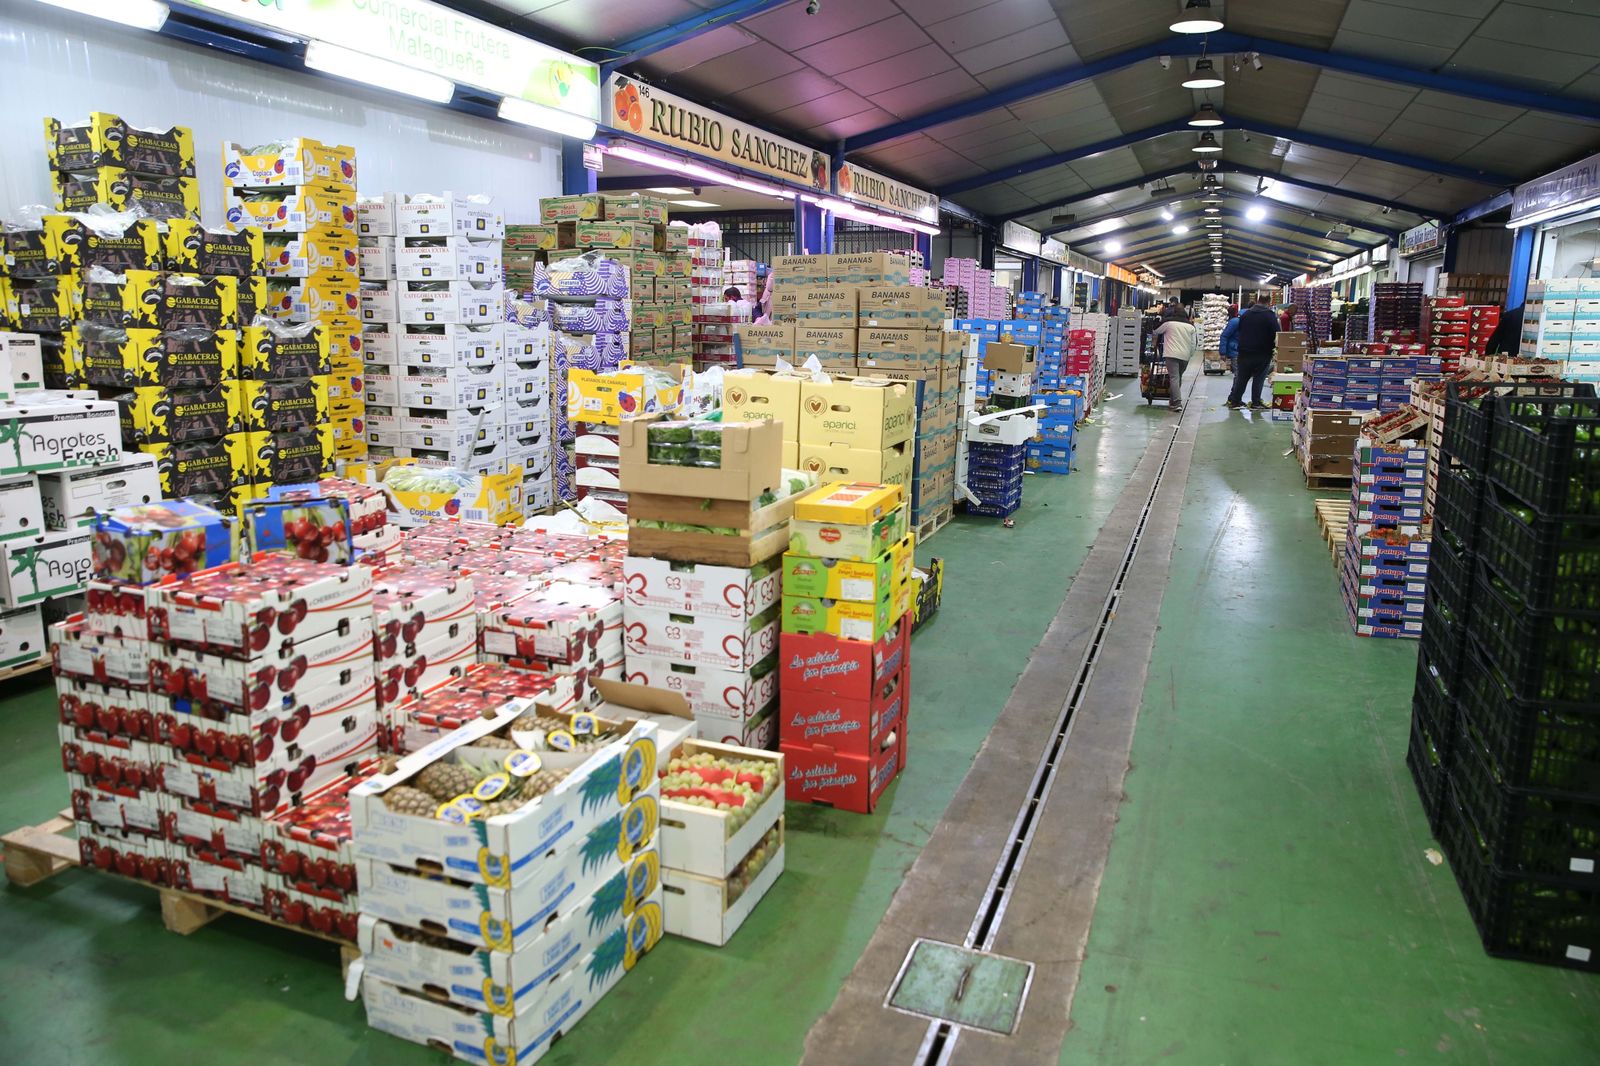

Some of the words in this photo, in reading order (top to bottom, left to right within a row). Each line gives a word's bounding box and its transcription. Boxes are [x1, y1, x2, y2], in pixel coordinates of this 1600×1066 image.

[454, 20, 510, 59] Frutera
[639, 85, 650, 98] 146
[138, 136, 178, 150] GABACERAS
[649, 97, 723, 152] RUBIO
[731, 127, 808, 179] SANCHEZ
[853, 171, 886, 203] RUBIO
[143, 189, 182, 200] GABACERAS
[213, 243, 250, 253] GABACERAS
[782, 257, 817, 266] BANANAS
[837, 256, 873, 265] BANANAS
[807, 292, 845, 300] BANANAS
[871, 291, 911, 299] BANANAS
[176, 296, 218, 306] GABACERAS
[747, 330, 784, 338] BANANAS
[806, 331, 843, 339] BANANAS
[870, 332, 909, 341] BANANAS
[178, 353, 219, 361] GABACERAS
[184, 402, 225, 412] GABACERAS
[279, 398, 314, 406] GABACERAS
[53, 413, 84, 422] Premium
[87, 410, 116, 418] Bananas
[743, 410, 774, 422] aparici
[884, 412, 906, 431] aparici
[823, 419, 856, 430] aparici
[32, 432, 106, 455] Agrotes
[62, 444, 119, 466] Fresh
[286, 445, 320, 455] GABACERAS
[186, 455, 228, 468] GABACERAS
[410, 507, 440, 518] Coplaca
[67, 535, 91, 546] Premiu
[789, 655, 804, 669] La
[806, 649, 839, 665] calidad
[803, 666, 819, 681] por
[820, 661, 860, 678] principio
[791, 712, 805, 727] La
[807, 708, 840, 724] calidad
[804, 724, 819, 739] por
[821, 720, 861, 737] principio
[789, 767, 803, 780] La
[805, 763, 837, 778] calidad
[802, 779, 817, 792] por
[819, 773, 857, 791] principio
